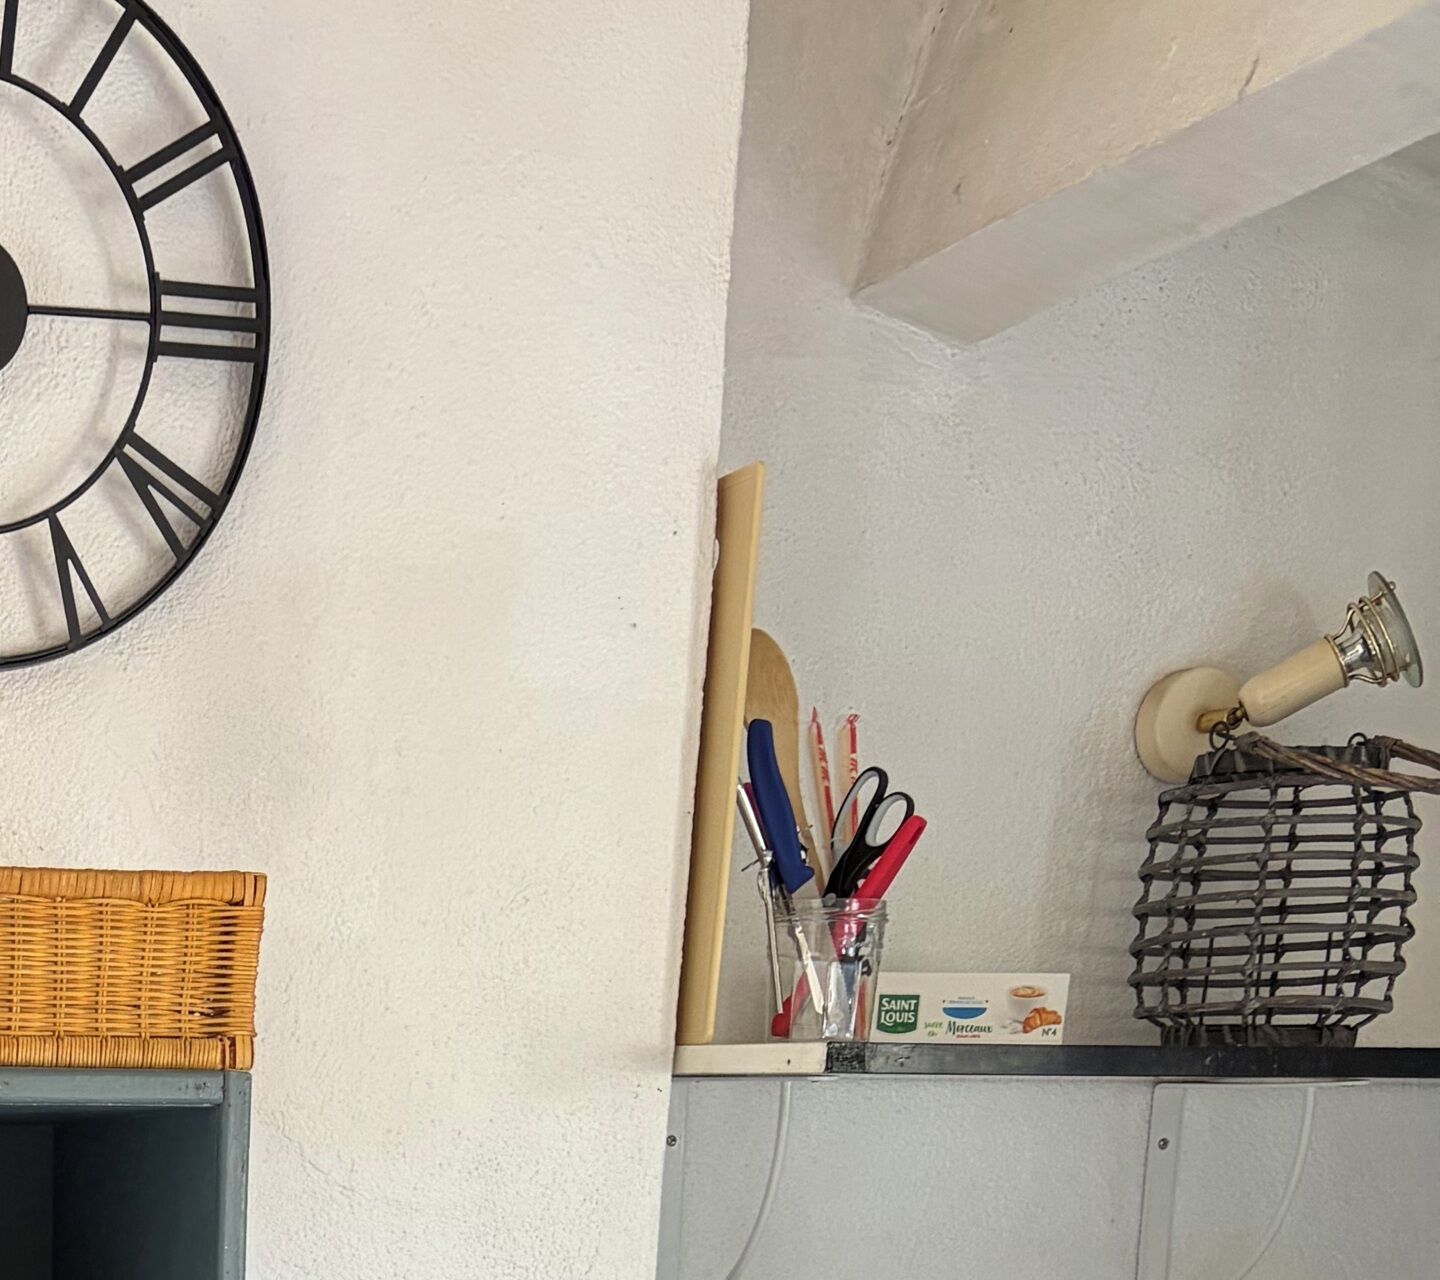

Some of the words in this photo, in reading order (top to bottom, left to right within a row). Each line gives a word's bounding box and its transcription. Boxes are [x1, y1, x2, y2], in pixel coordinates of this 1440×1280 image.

[123, 120, 234, 214] II
[157, 278, 258, 364] III
[46, 512, 110, 645] V
[880, 1011, 915, 1026] LOUIS
[881, 998, 917, 1010] SAINT
[945, 1020, 993, 1035] Morceaux
